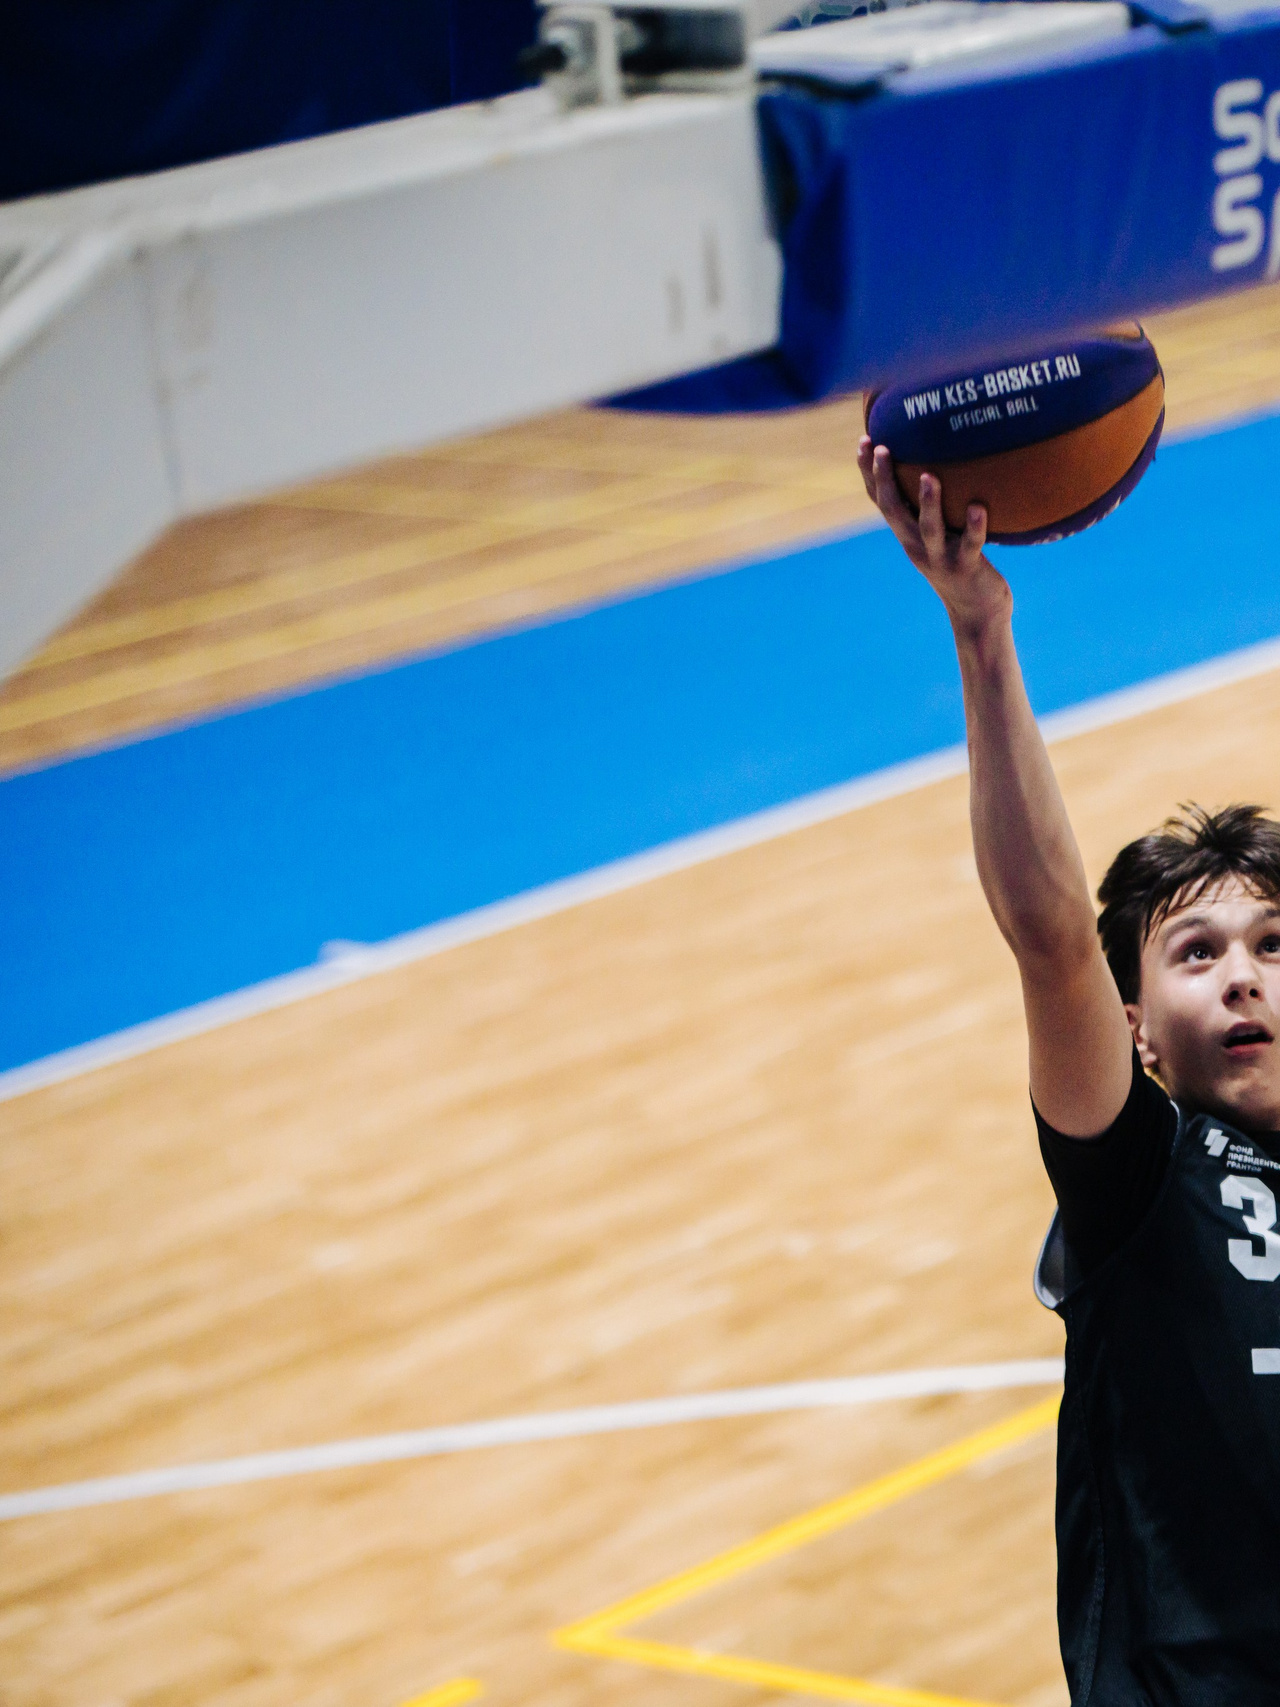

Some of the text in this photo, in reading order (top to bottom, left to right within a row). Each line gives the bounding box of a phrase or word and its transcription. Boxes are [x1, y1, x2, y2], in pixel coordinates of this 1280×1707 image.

[903, 353, 1081, 420] WWW.KES-BASKET.RU
[949, 394, 1039, 432] OFFICIAL BALL
[1229, 1144, 1254, 1156] ФОНД
